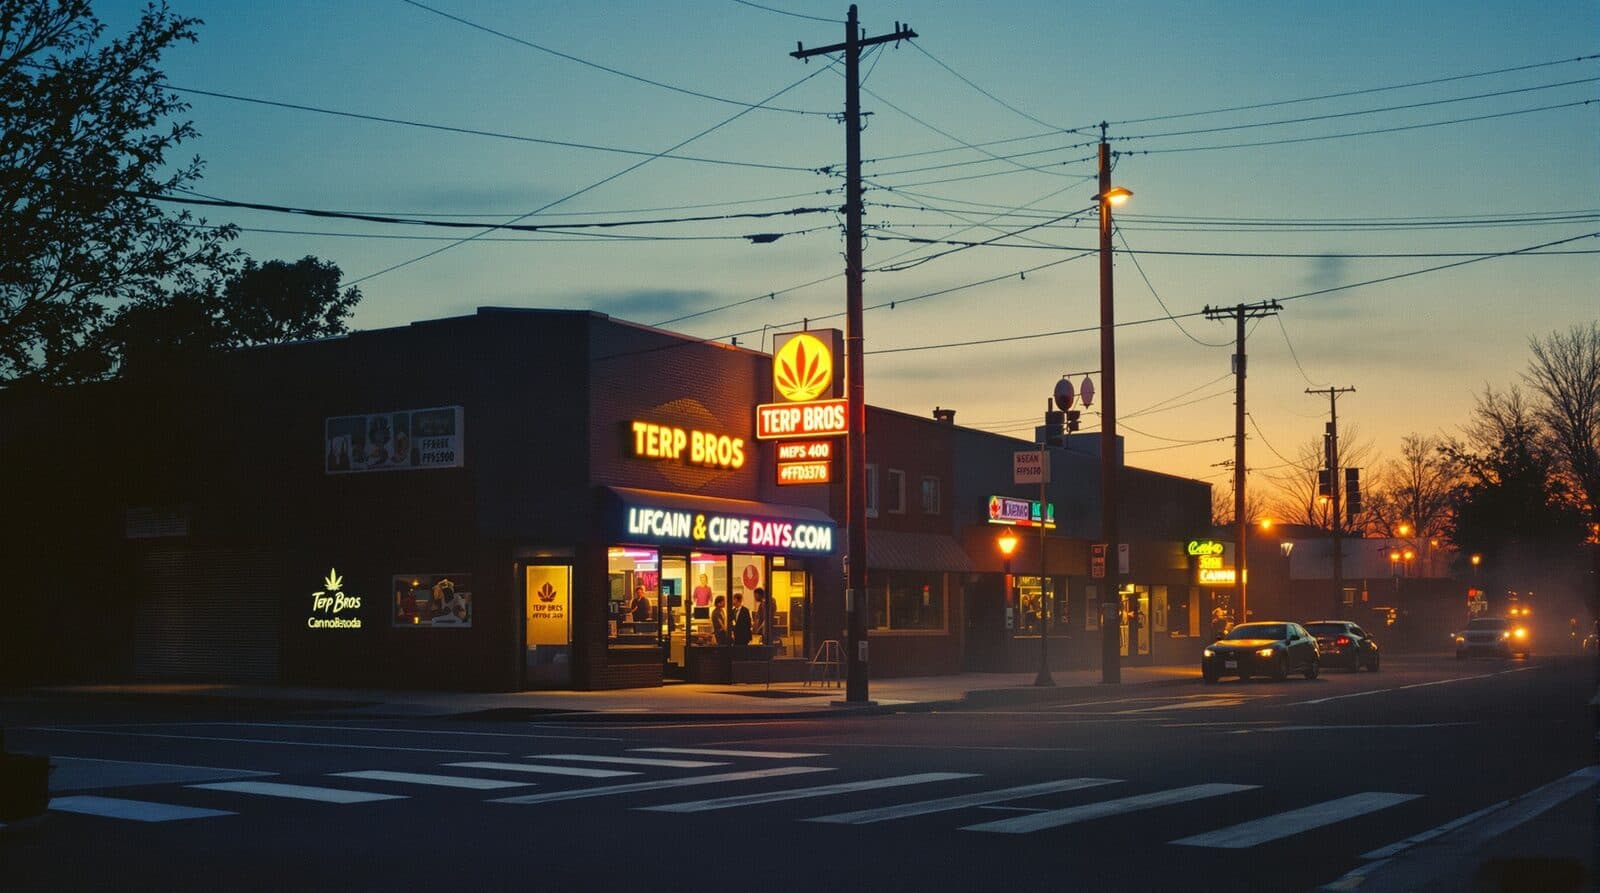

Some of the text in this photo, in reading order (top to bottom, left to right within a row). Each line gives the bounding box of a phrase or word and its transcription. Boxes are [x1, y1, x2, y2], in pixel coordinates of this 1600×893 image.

[762, 405, 845, 433] TERP BROS
[632, 421, 745, 469] TERP BROS
[808, 443, 829, 458] 400
[629, 507, 832, 550] LIFCAIN & CURE DAYS.COM
